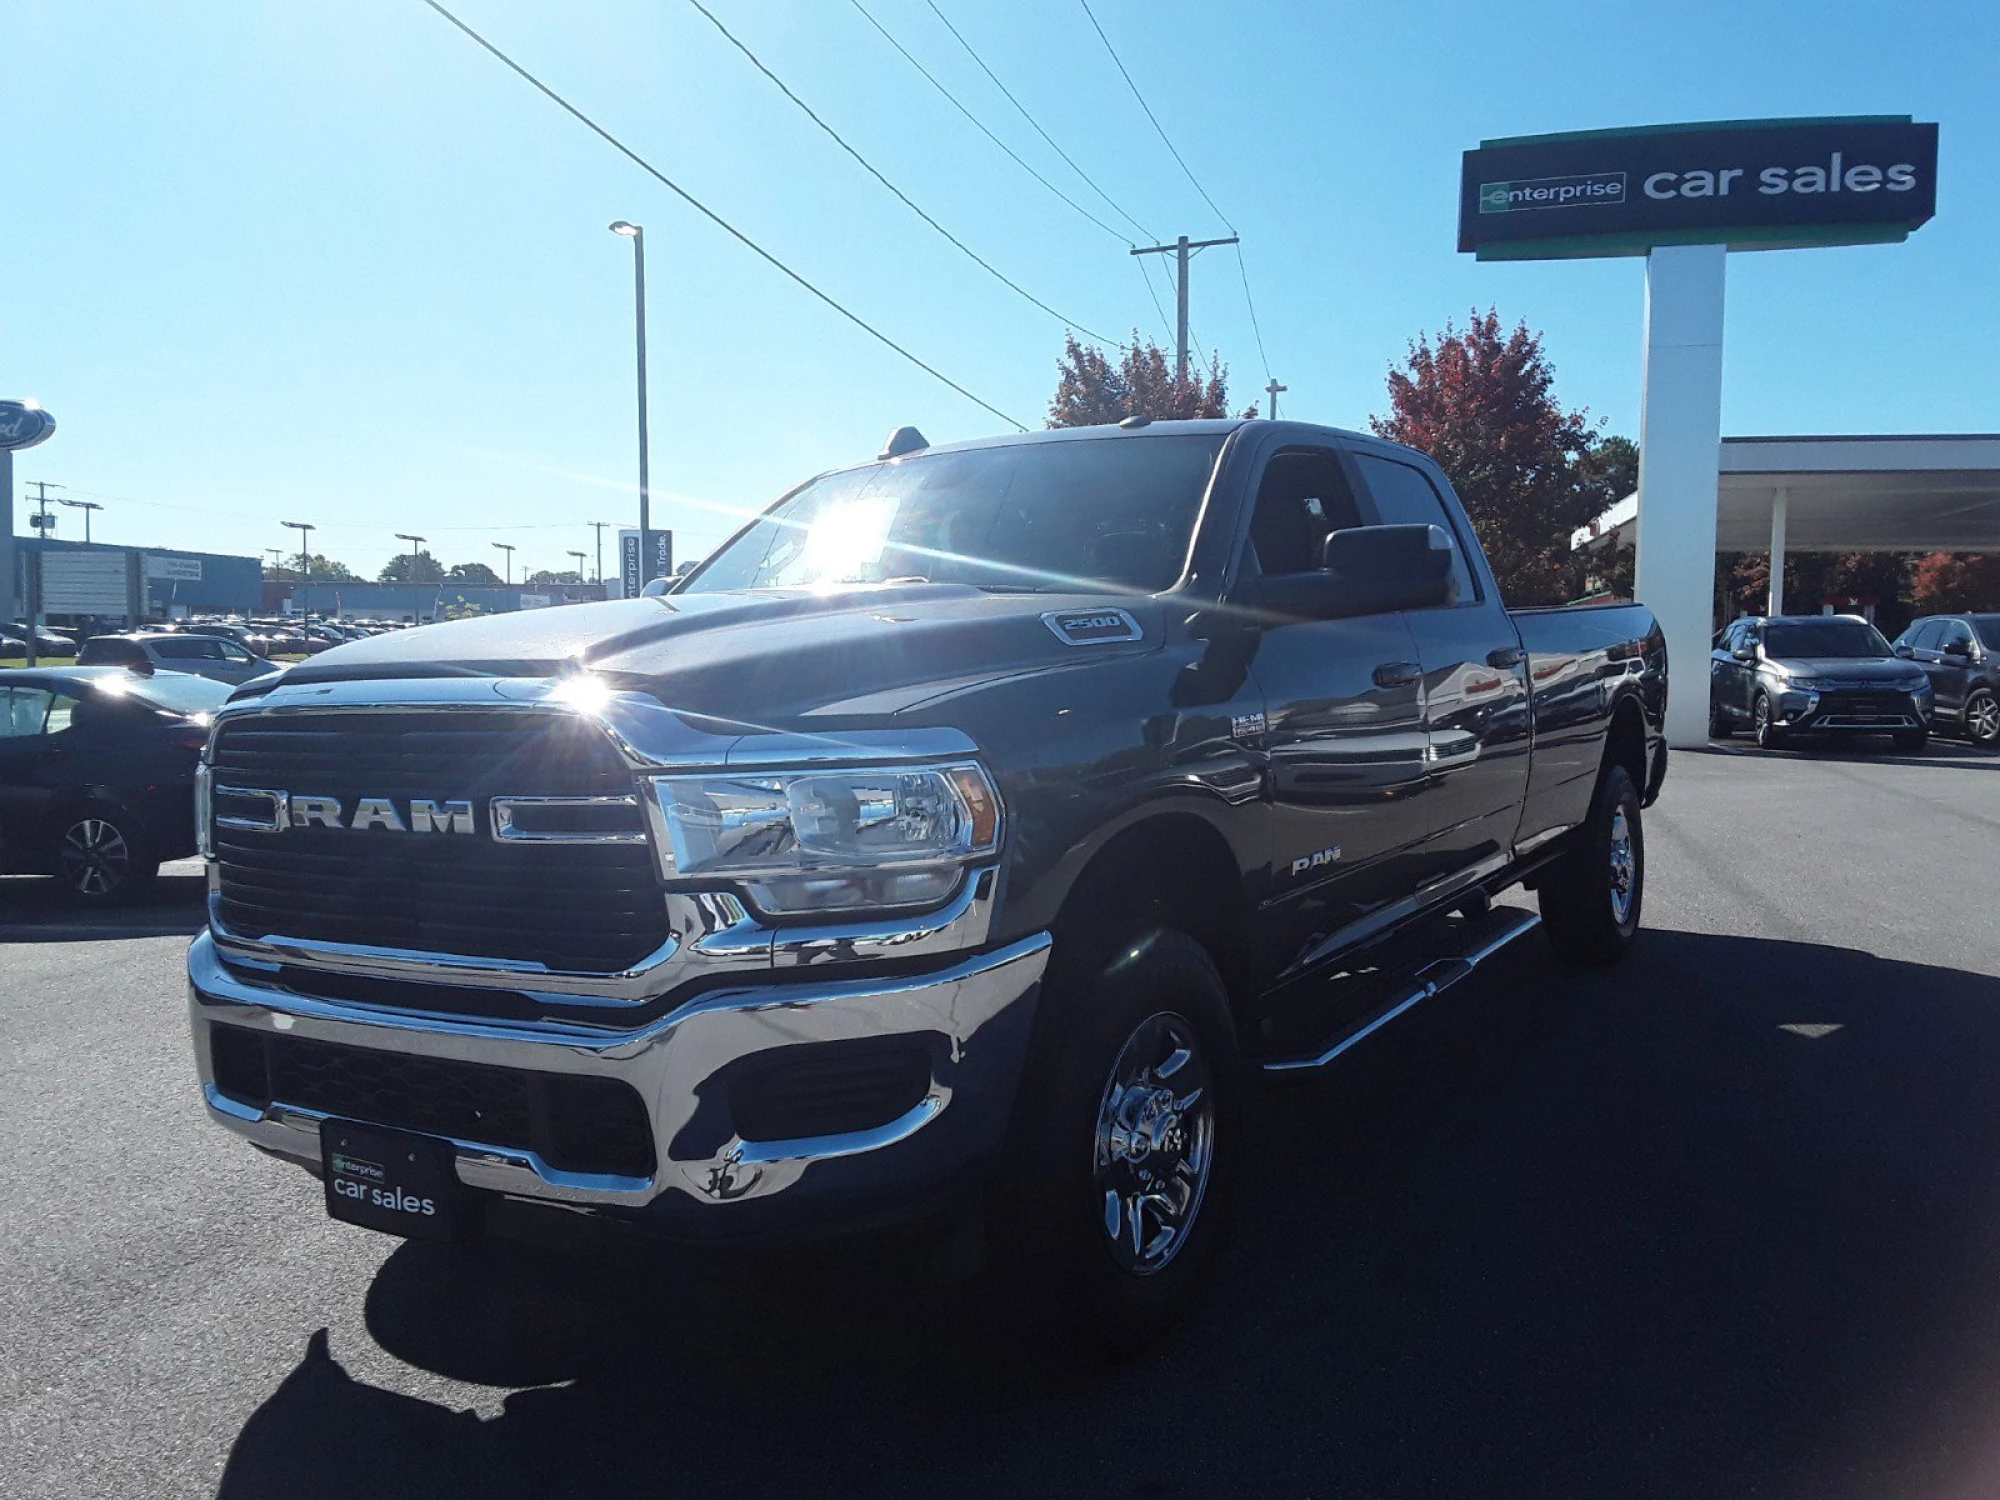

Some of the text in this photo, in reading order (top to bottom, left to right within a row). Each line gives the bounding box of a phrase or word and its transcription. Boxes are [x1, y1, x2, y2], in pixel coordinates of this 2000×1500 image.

[1489, 151, 1917, 205] enterprise car sales
[626, 537, 638, 599] nterprise
[1064, 615, 1121, 631] 2500
[291, 795, 475, 835] RAM
[334, 1178, 436, 1217] car sales
